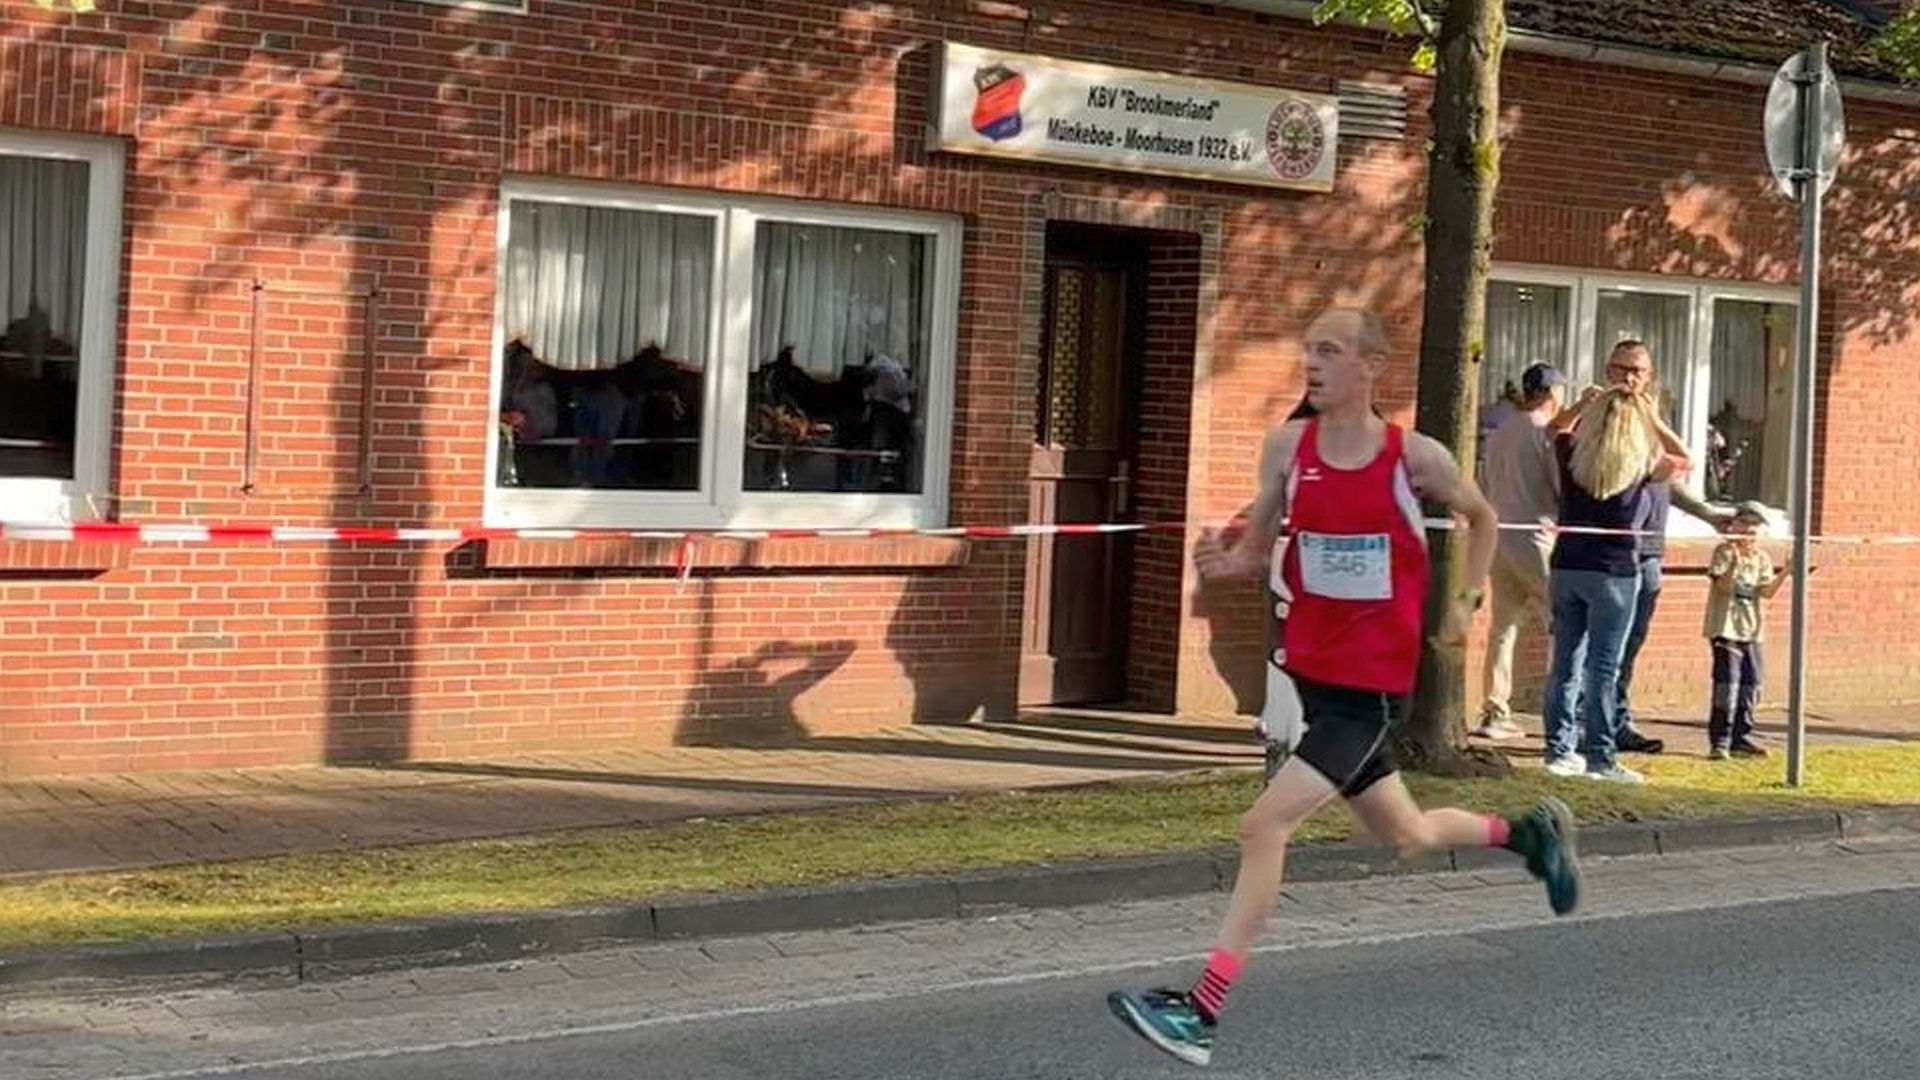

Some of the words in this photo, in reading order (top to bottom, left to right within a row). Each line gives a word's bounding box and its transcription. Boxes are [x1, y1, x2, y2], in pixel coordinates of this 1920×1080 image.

[1087, 86, 1118, 108] KBV
[1121, 88, 1220, 121] "Brookmerland"
[1047, 118, 1114, 147] Münkeboe
[1124, 128, 1193, 155] Moorhusen
[1197, 134, 1228, 160] 1932
[1229, 140, 1252, 162] e.V.
[1322, 553, 1367, 576] 546
